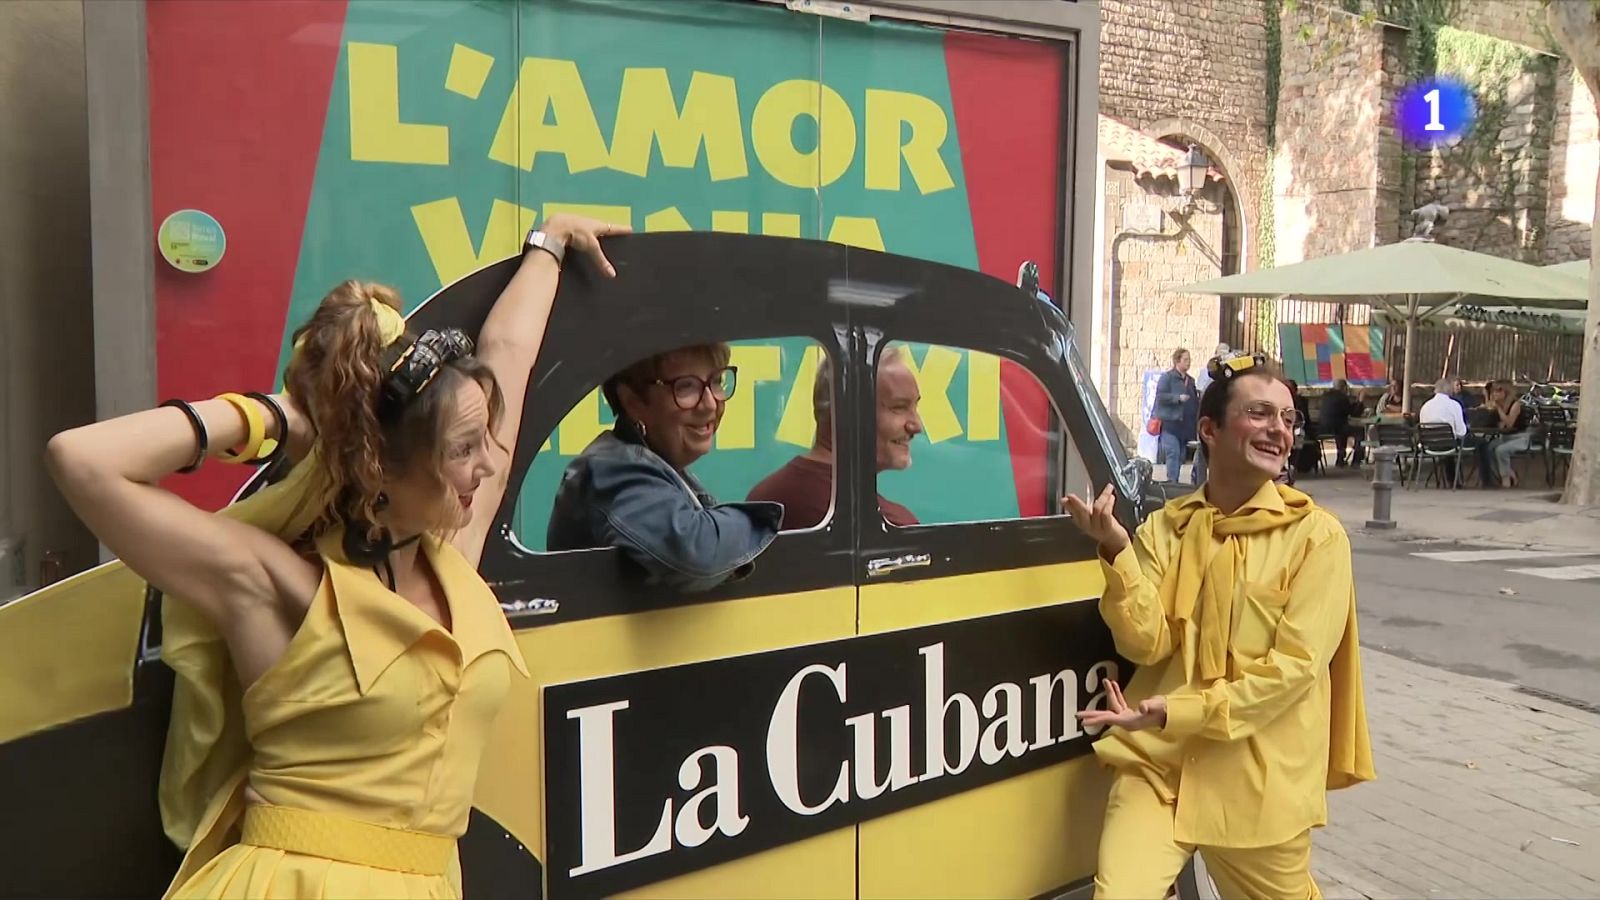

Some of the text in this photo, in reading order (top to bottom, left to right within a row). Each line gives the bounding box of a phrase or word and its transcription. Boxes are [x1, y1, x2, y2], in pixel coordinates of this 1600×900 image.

[347, 41, 955, 195] L'AMOR
[566, 641, 1119, 878] La Cubana
